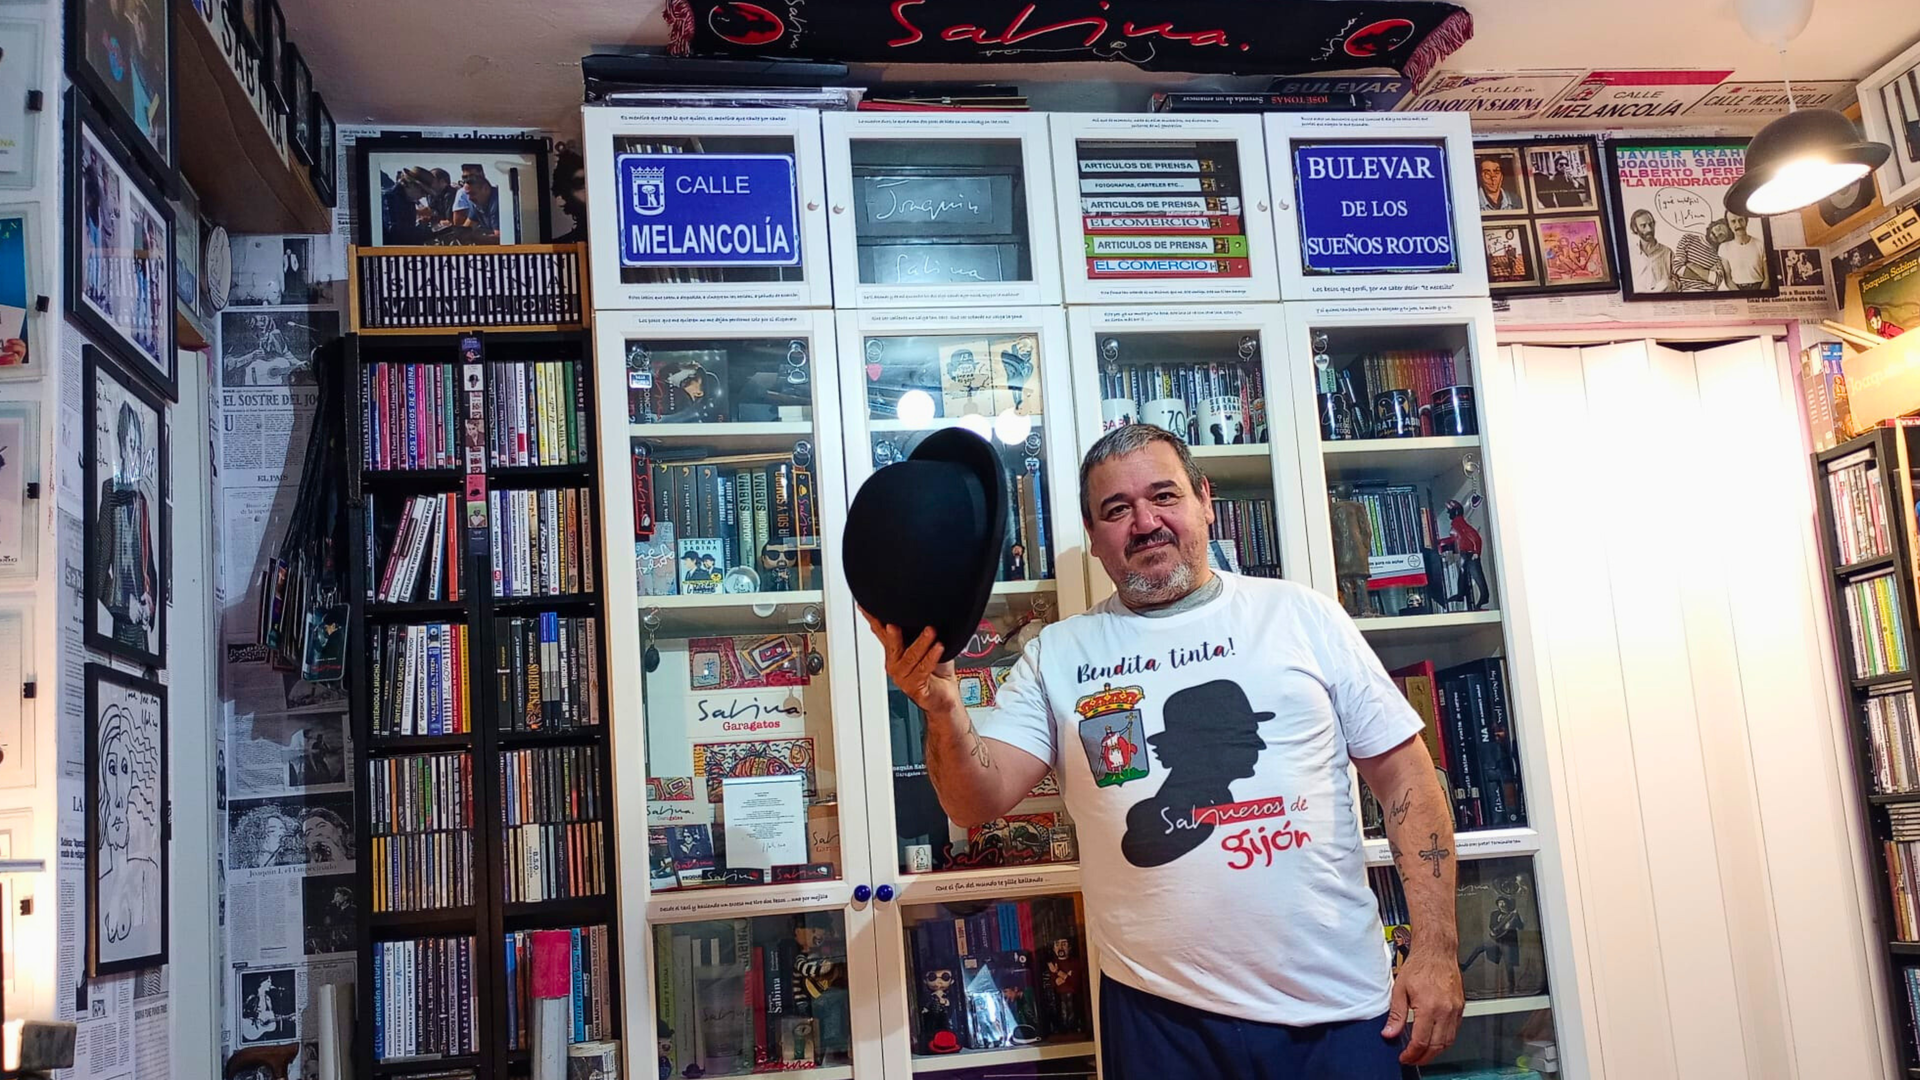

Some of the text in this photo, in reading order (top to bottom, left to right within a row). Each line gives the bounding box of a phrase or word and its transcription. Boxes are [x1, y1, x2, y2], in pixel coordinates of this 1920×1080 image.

[1282, 82, 1401, 94] BULEVAR
[1613, 91, 1664, 99] CALLE
[1485, 98, 1544, 111] SABINA
[1546, 99, 1682, 118] MELANCOLÍA
[1618, 151, 1681, 159] JAVIER
[1306, 156, 1435, 180] BULEVAR
[1618, 159, 1744, 169] JOAQUIN SABIN
[1619, 167, 1745, 178] ALBERTO PERE
[676, 176, 750, 194] CALLE
[1649, 176, 1739, 187] MANDRAGOR
[1090, 201, 1200, 209] ARTICULOS DE PRENSA
[1340, 200, 1408, 217] DE LOS
[1090, 218, 1199, 227] EL COMERCIO
[632, 216, 790, 254] MELANCOLÍA
[1097, 241, 1208, 249] ARTICULOS DE PRENSA
[1308, 233, 1450, 255] SUEÑOS ROTOS
[1095, 261, 1208, 270] EL COMERCIO
[1890, 259, 1918, 278] Sabina
[1339, 286, 1351, 295] que
[1369, 286, 1378, 294] por
[223, 395, 235, 406] EL
[239, 393, 279, 406] SOSTRE
[282, 393, 299, 406] DEL
[257, 474, 268, 482] EL
[738, 474, 752, 542] JOAQUÍN SABINA
[753, 473, 768, 542] JOAQUÍN SABINA
[777, 512, 789, 527] SOL
[403, 565, 416, 595] CUALQUIER
[417, 525, 427, 546] PASADO
[1076, 637, 1236, 684] Bendita tinta!
[430, 678, 436, 686] AL
[394, 657, 405, 723] SINTIÉNDOLO MUCHO
[372, 687, 380, 730] SINTIÉNDOLO
[722, 720, 781, 732] Garagatos
[1480, 727, 1490, 743] NA
[72, 796, 83, 812] LA
[1160, 795, 1309, 835] Sabineros de
[975, 880, 997, 888] mundo
[592, 950, 598, 958] DE
[771, 978, 783, 1014] Sabina
[374, 990, 382, 1026] conexión
